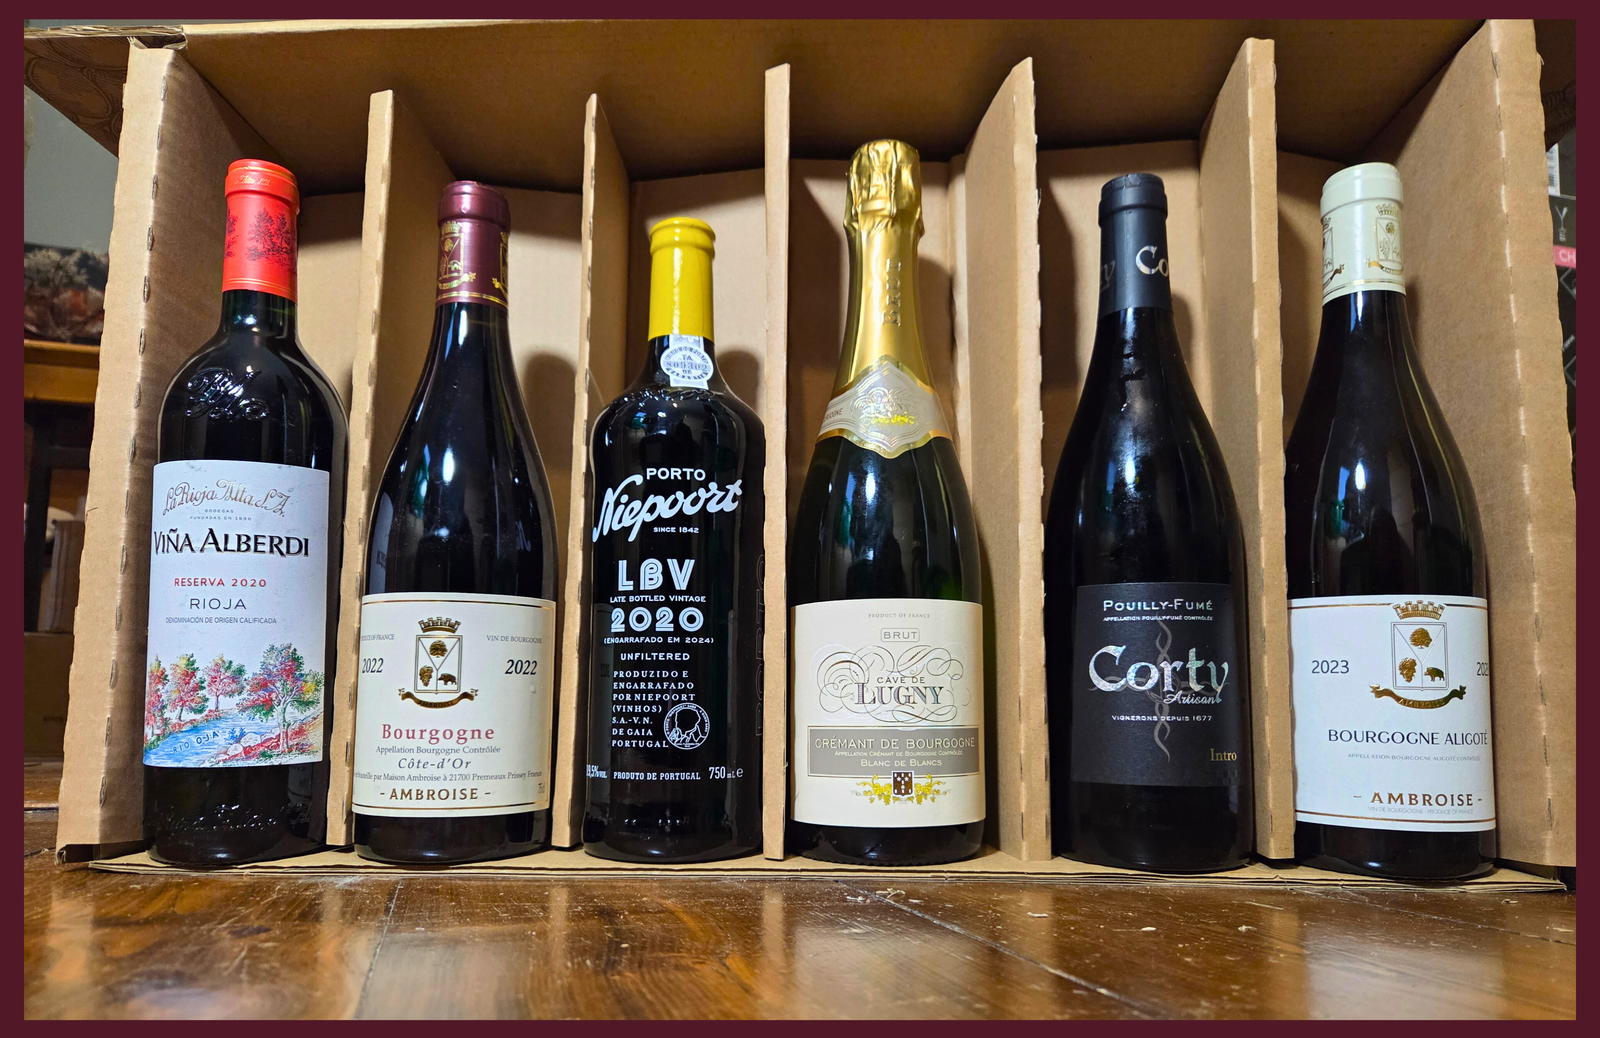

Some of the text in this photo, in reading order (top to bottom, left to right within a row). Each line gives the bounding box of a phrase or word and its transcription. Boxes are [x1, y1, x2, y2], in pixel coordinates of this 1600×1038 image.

[646, 468, 706, 481] PORTO
[174, 482, 216, 506] Rioja
[592, 474, 742, 543] Niepoort
[154, 528, 310, 558] VIÑA ALBERDI
[618, 558, 696, 592] LBV
[174, 577, 267, 588] RESERVA 2020
[190, 598, 246, 610] RIOJA
[1102, 598, 1213, 612] POUILLY-FUMÉ
[165, 616, 204, 624] DENOMINACIÓN
[610, 606, 704, 632] 2020
[604, 636, 664, 644] (ENGARRAFADO
[884, 632, 918, 640] BRUT
[620, 652, 690, 661] UNFILTERED
[362, 658, 384, 674] 2022
[504, 658, 538, 676] 2022
[1311, 659, 1350, 674] 2023
[614, 670, 678, 678] PRODUZIDO
[876, 676, 926, 684] CAVE DE
[1089, 644, 1230, 704] Corty
[613, 682, 694, 690] ENGARRAFADO
[854, 682, 945, 706] LUGNY
[1164, 690, 1216, 704] Artisan
[612, 704, 662, 714] (VINHOS)
[382, 724, 494, 746] Bourgogne
[612, 728, 654, 736] DE GAIA
[1328, 728, 1488, 746] BOURGOGNE ALIGOTÉ
[172, 730, 220, 754] RIO OJA
[612, 740, 669, 748] PORTUGAL
[814, 735, 976, 750] CRÉMANT DE BOURGOGNE
[376, 746, 501, 756] Appellation Bourgogne Contrôlée
[1210, 748, 1238, 762] Intro
[860, 758, 891, 767] BLANC
[910, 759, 943, 767] BLANCS
[383, 772, 406, 781] Maison
[613, 772, 644, 780] PRODUTO
[646, 772, 658, 780] DE
[660, 772, 700, 780] PORTUGAL
[389, 788, 478, 801] AMBROISE
[1370, 792, 1474, 806] AMBROISE
